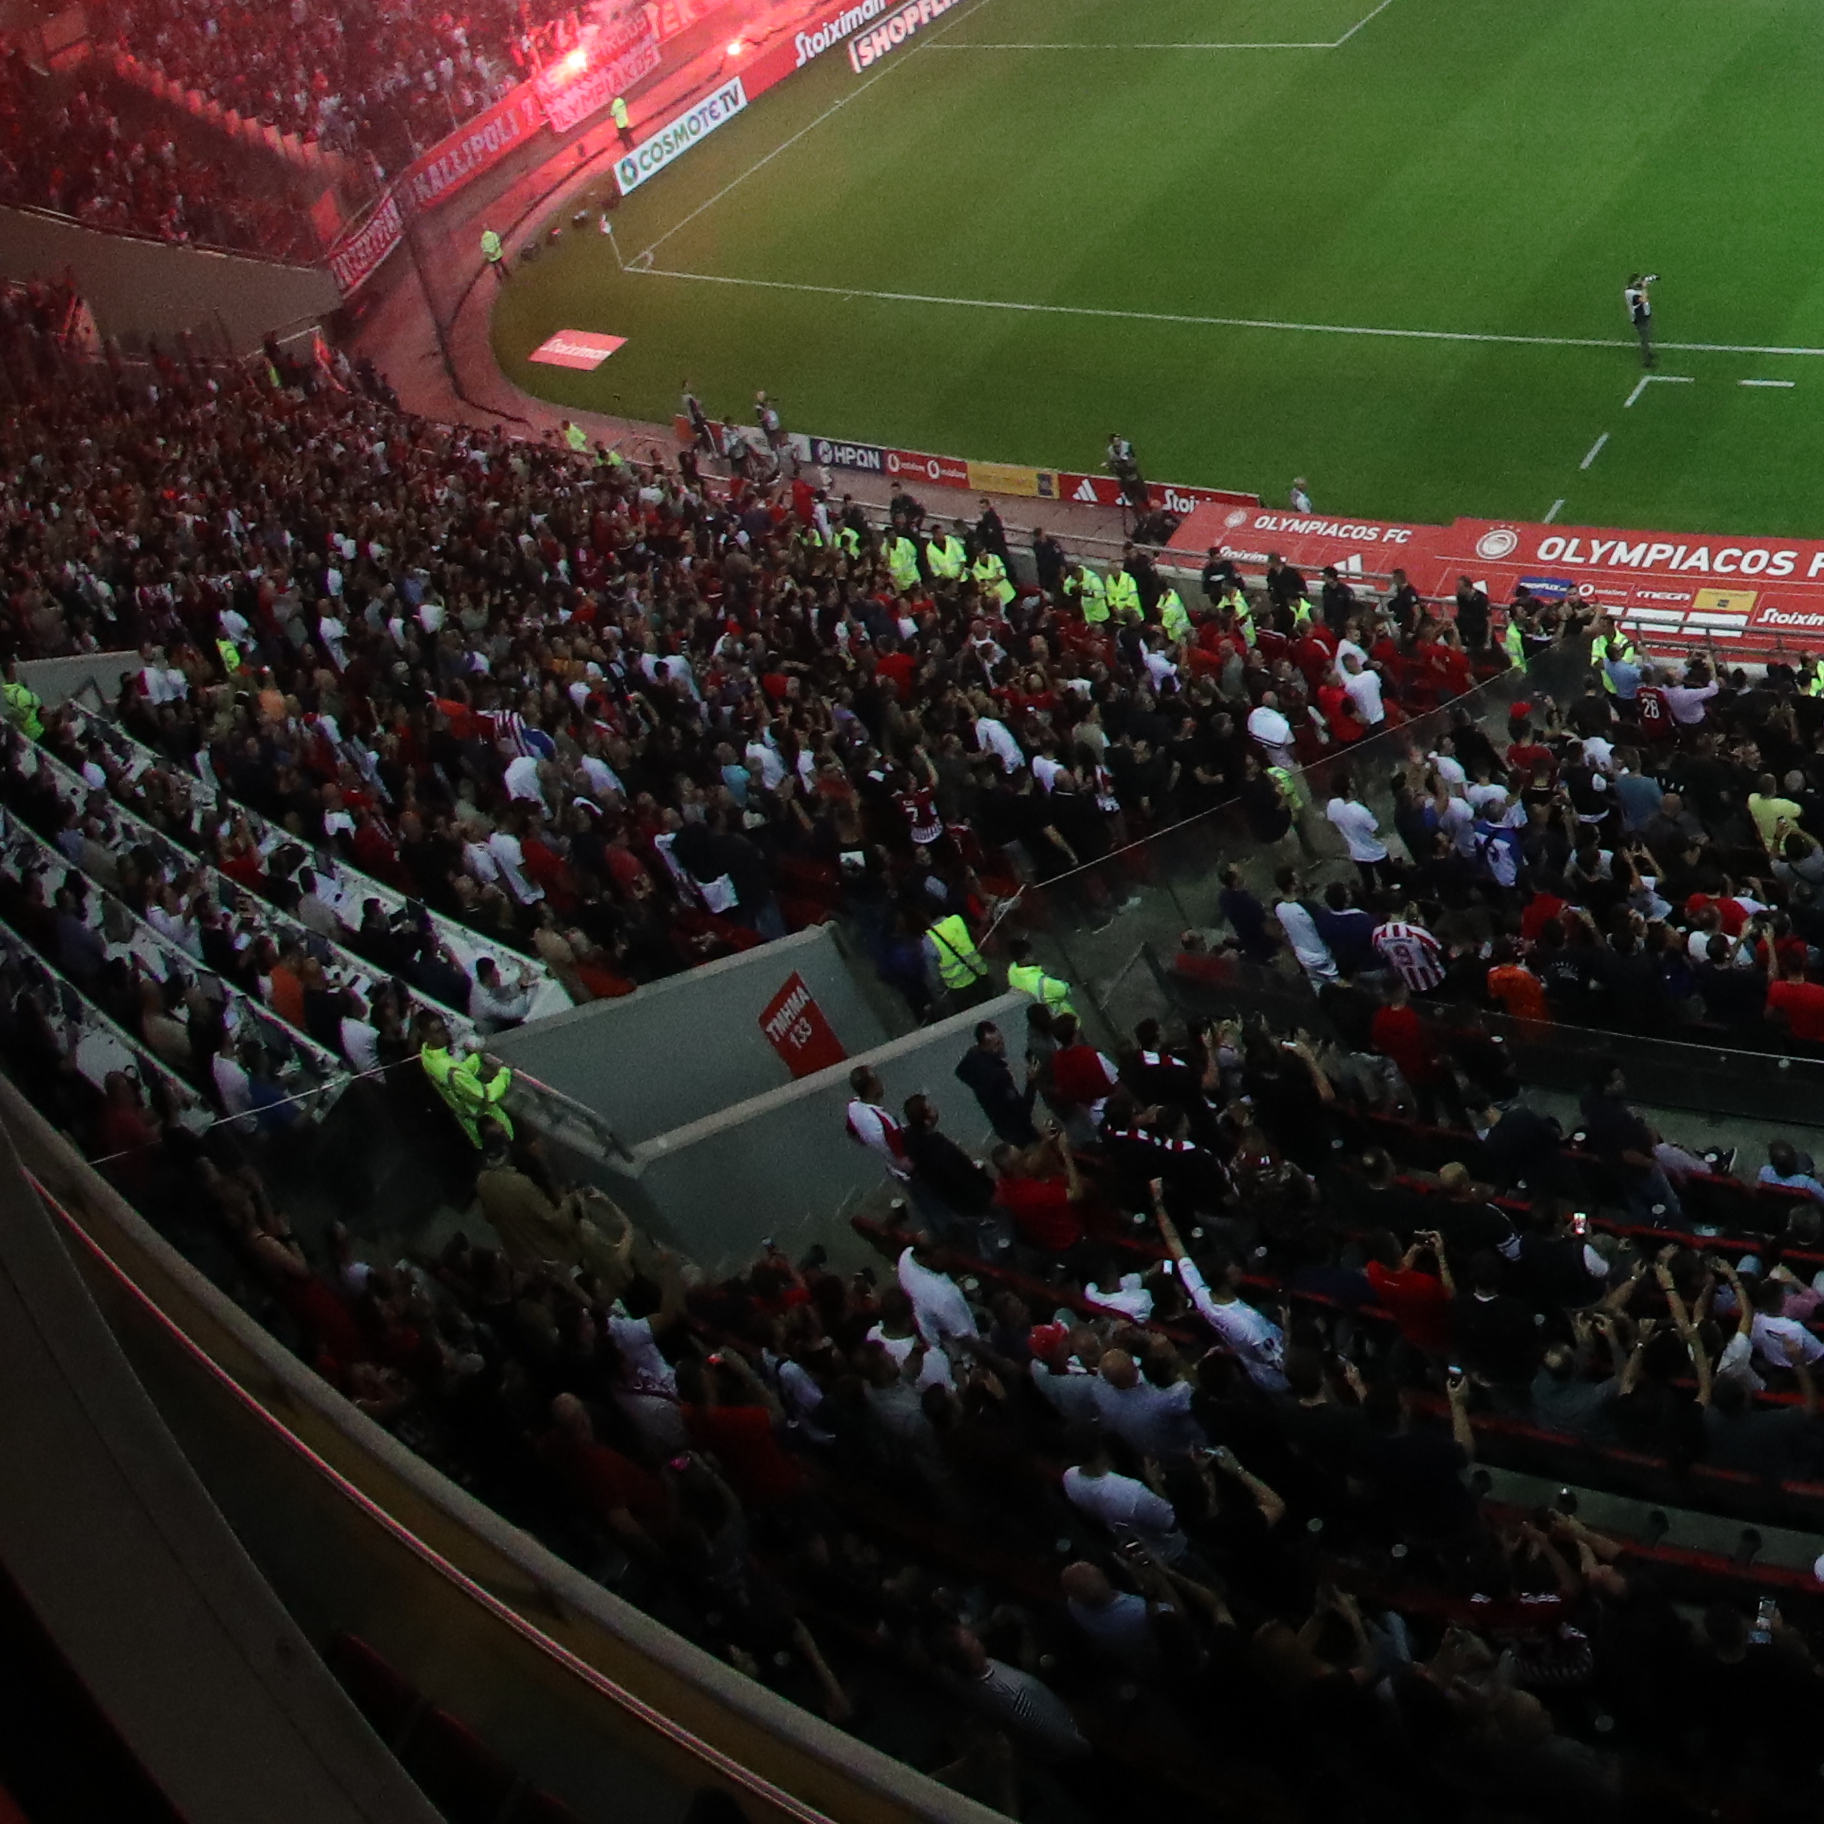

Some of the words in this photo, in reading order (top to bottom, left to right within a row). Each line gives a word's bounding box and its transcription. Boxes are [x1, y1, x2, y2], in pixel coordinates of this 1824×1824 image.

[639, 100, 721, 171] COSMOTE
[719, 85, 739, 113] TV
[835, 446, 880, 469] ΗΡΩΝ
[1254, 515, 1380, 542] OLYMPIACOS
[1382, 528, 1412, 543] FC
[1537, 537, 1798, 576] OLYMPIACOS
[1641, 698, 1660, 719] 28
[906, 807, 918, 823] 7
[1394, 945, 1414, 967] 9
[765, 985, 812, 1044] ΤΜΗΜΑ
[789, 1017, 813, 1049] 133
